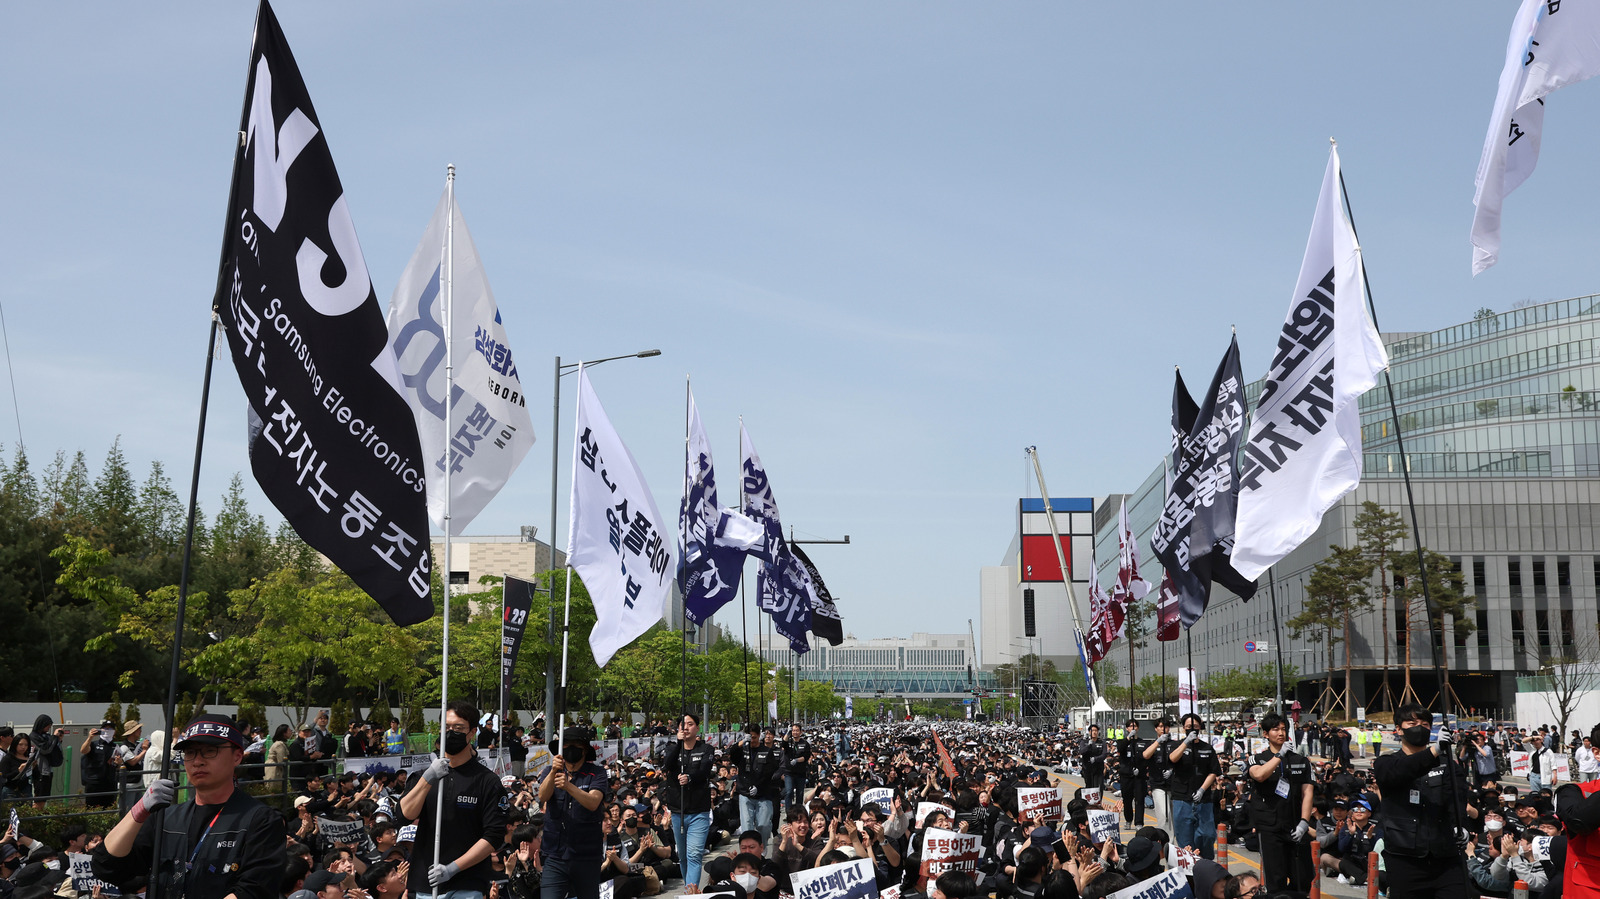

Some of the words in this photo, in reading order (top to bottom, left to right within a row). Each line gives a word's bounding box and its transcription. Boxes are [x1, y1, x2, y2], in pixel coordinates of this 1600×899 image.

[263, 298, 324, 396] Samsung
[322, 386, 426, 494] Electronics
[488, 376, 526, 408] EBORN
[580, 426, 671, 587] 삼스플레이
[1021, 789, 1058, 806] 투명하게
[1084, 792, 1100, 802] 투명
[927, 836, 976, 854] 투명하게
[73, 861, 92, 874] 상한
